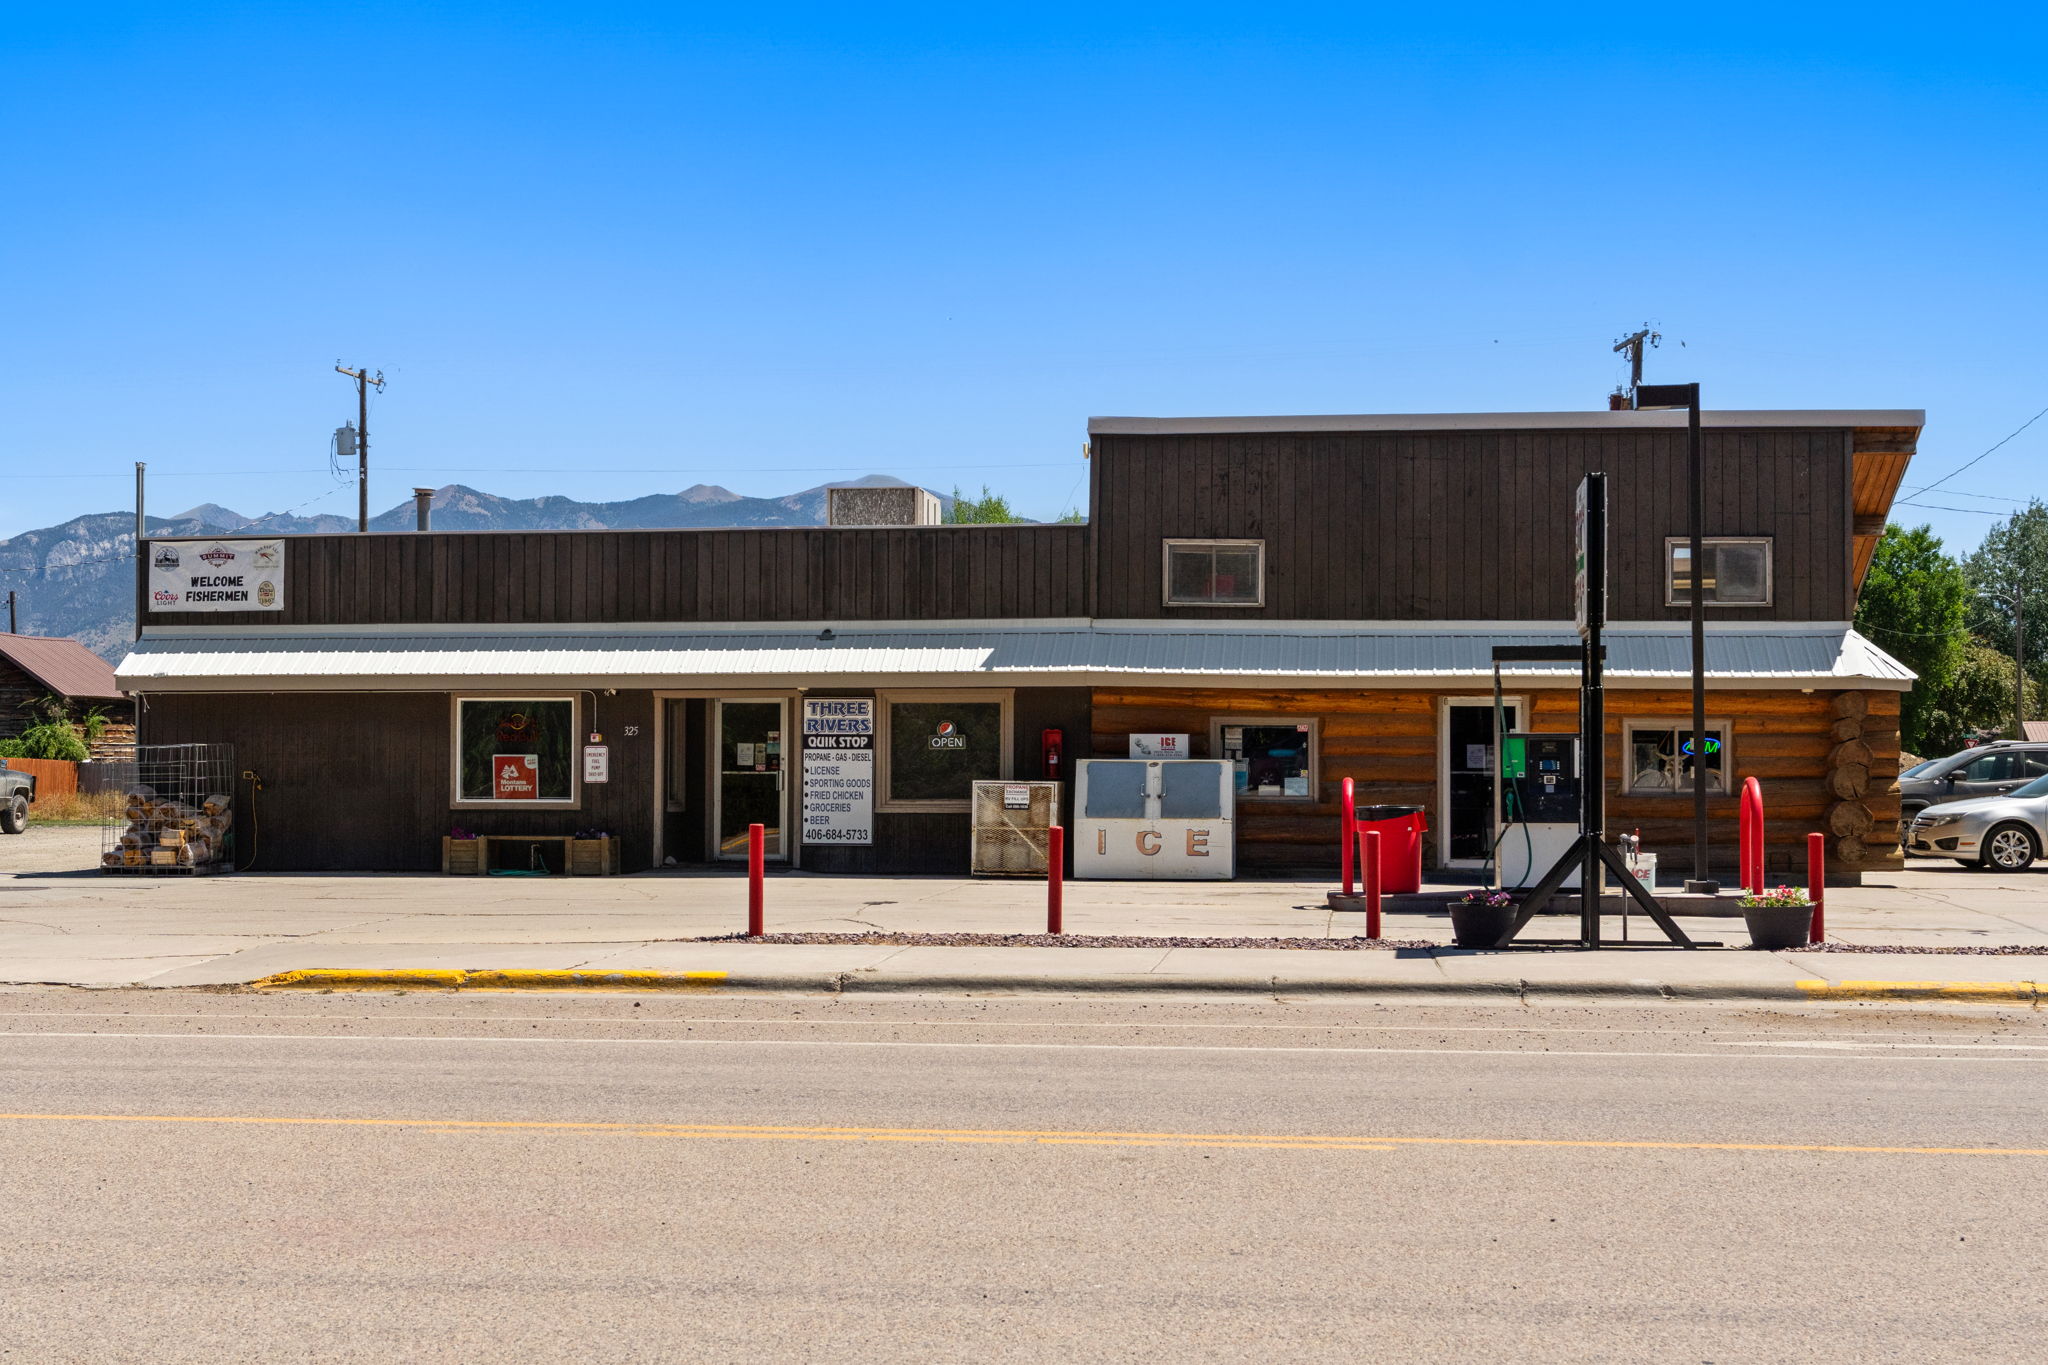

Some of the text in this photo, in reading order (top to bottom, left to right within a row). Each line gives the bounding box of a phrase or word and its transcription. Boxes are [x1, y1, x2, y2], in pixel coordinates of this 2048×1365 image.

[191, 576, 243, 587] WELCOME
[154, 591, 178, 601] Coors
[186, 591, 248, 602] FISHERMEN
[807, 701, 869, 717] THREE
[624, 726, 639, 736] 325
[806, 718, 871, 734] RIVERS
[808, 736, 868, 748] QUIK STOP
[931, 737, 963, 747] OPEN
[1160, 737, 1176, 746] ICE
[805, 753, 871, 761] PROPANE GAS DIESEL
[810, 766, 840, 775] LICENSE
[810, 779, 871, 787] SPORTING GOODS
[810, 791, 863, 800] FRIED CHICKEN
[810, 803, 851, 812] GROCERIES
[810, 816, 829, 824] BEER
[805, 829, 868, 840] 406-684-5733
[1098, 828, 1210, 857] ICE
